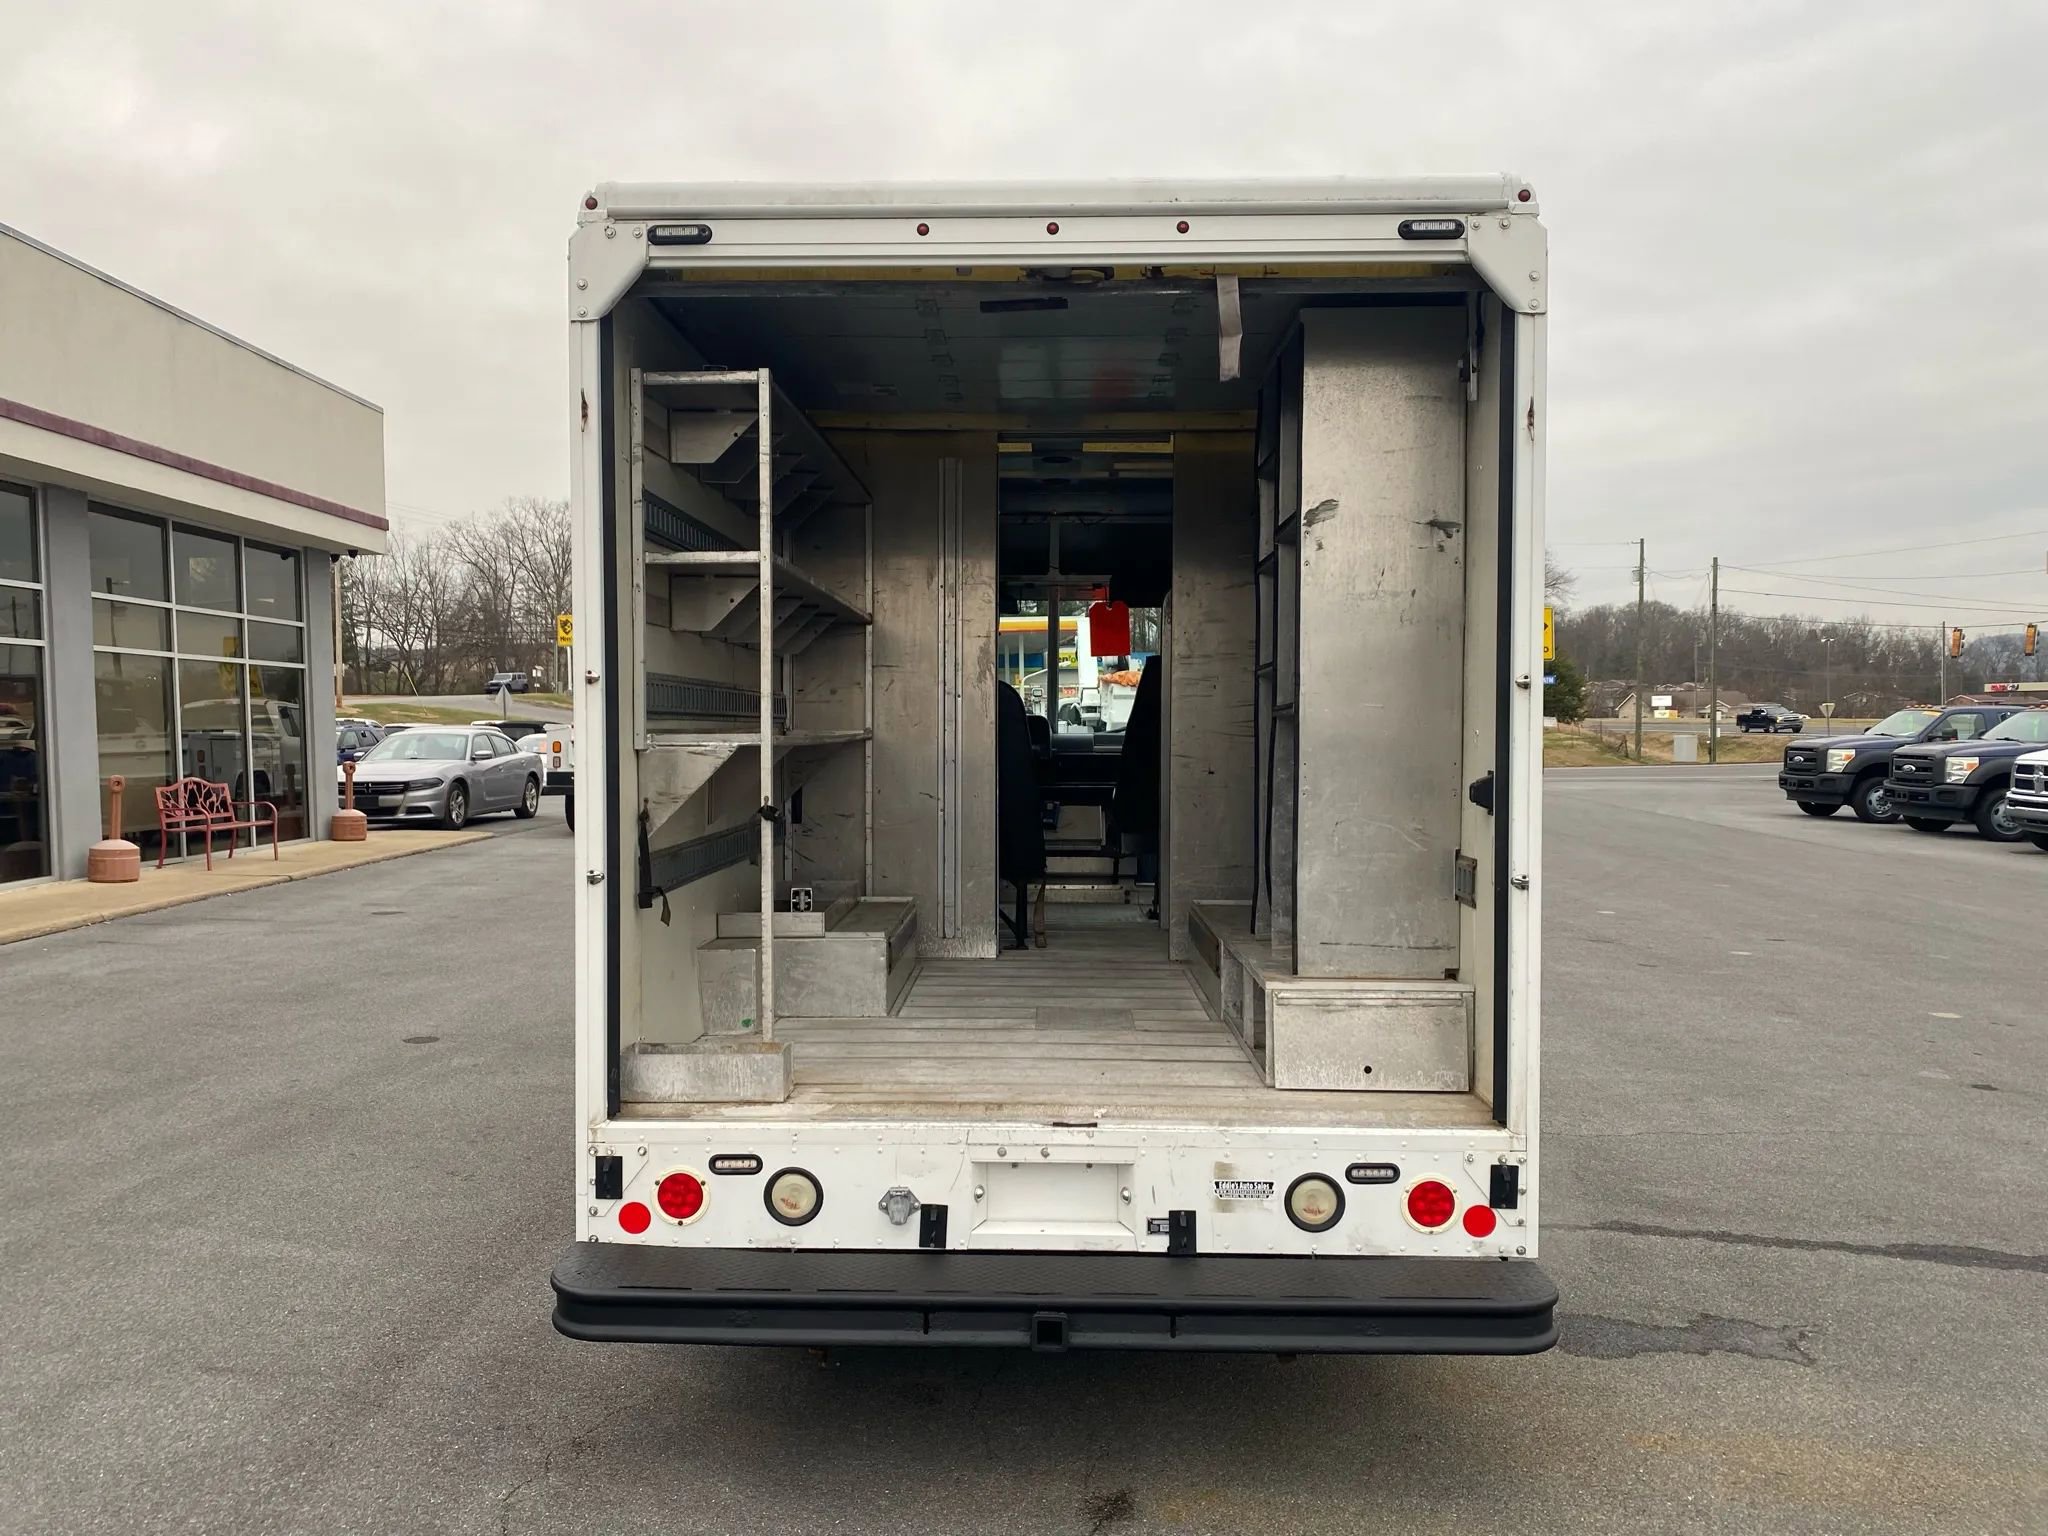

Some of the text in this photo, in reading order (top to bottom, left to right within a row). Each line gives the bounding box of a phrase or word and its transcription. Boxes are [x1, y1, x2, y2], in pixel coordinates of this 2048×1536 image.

[1219, 1181, 1269, 1190] Eddie's Auto Sales
